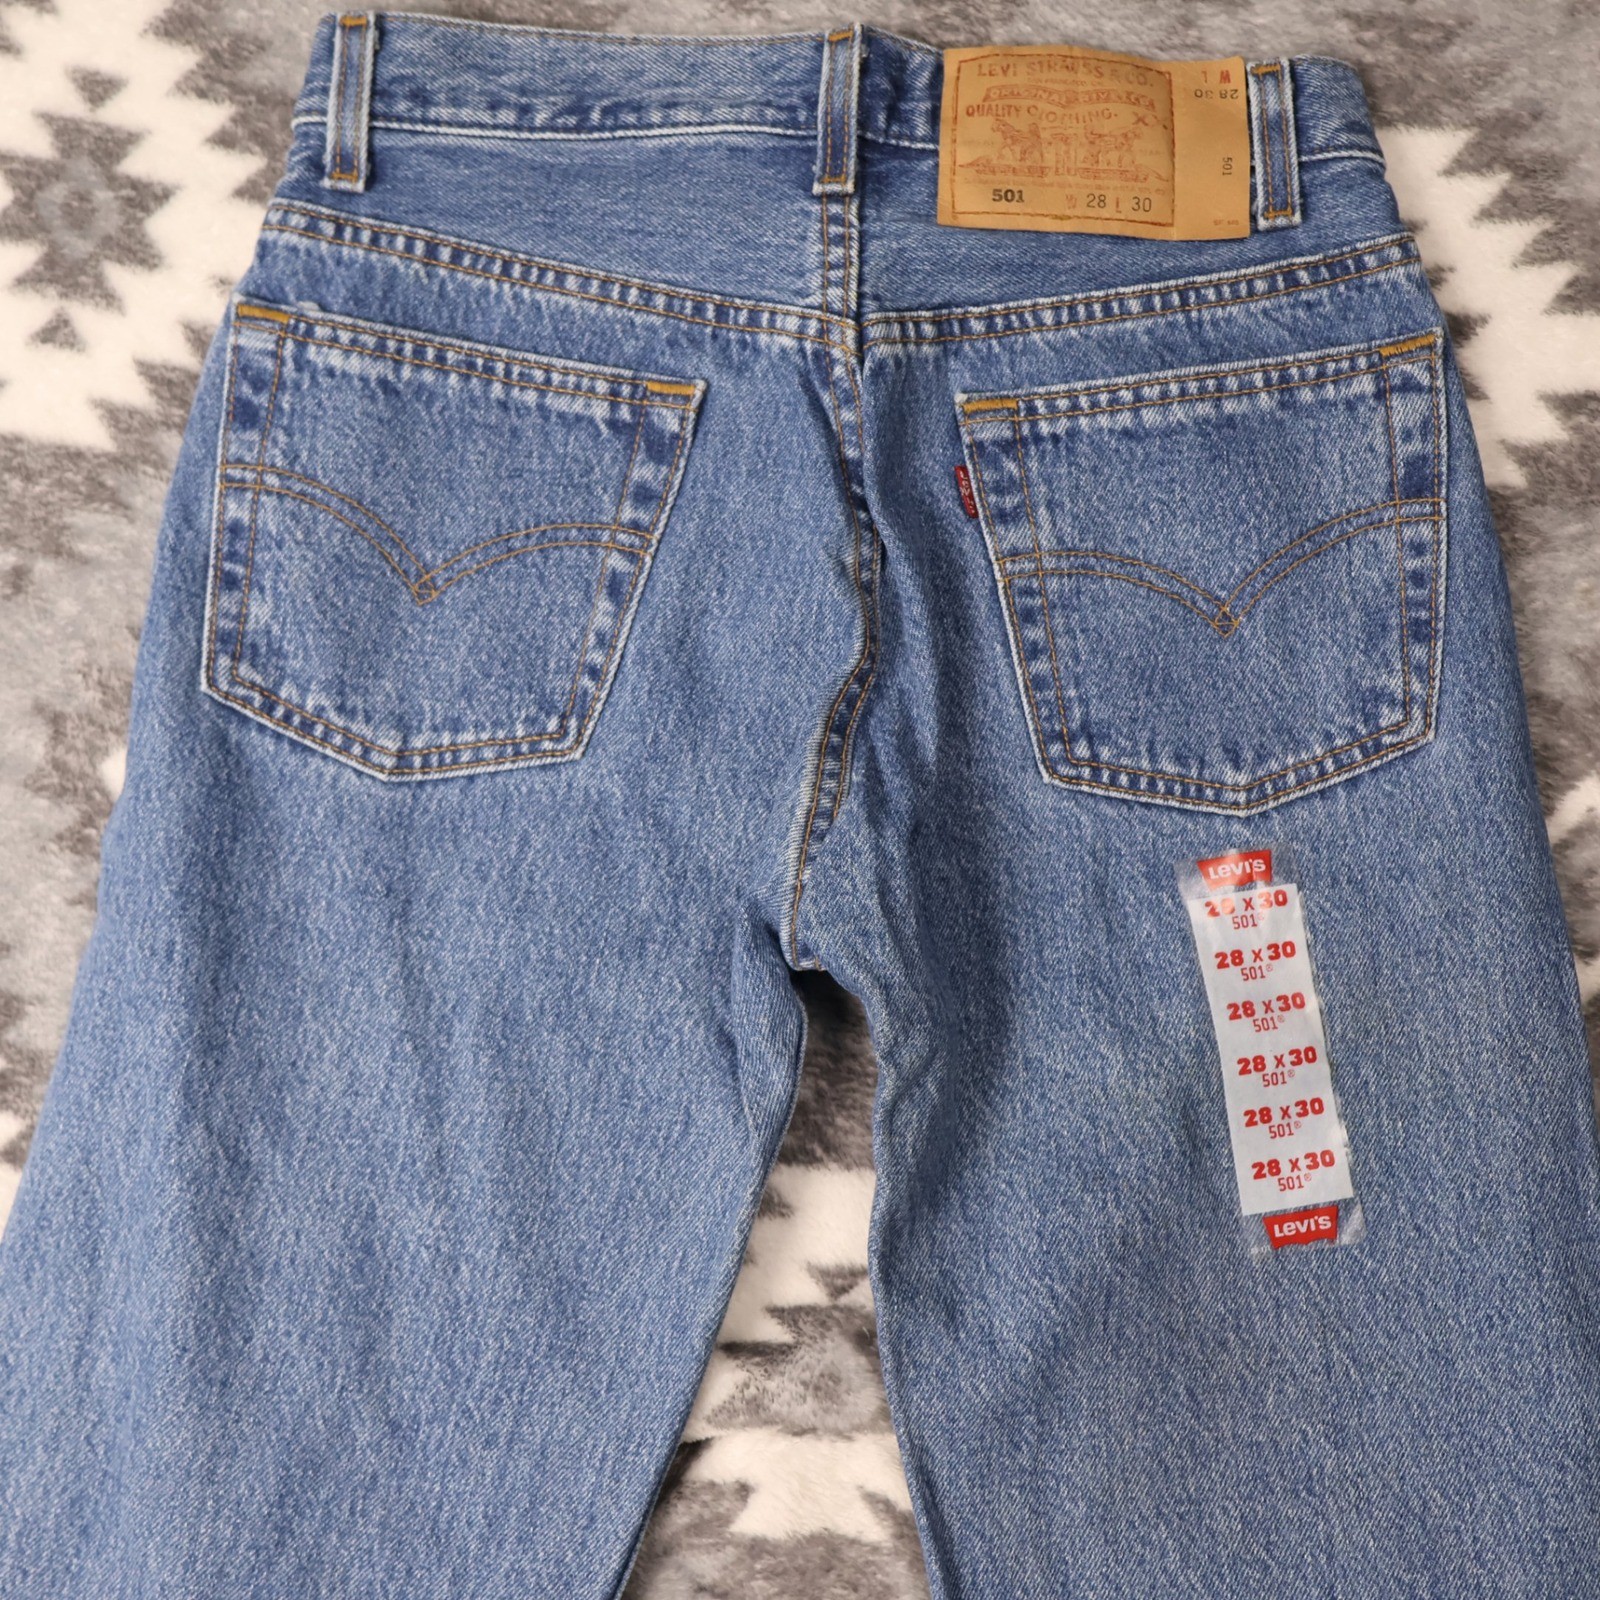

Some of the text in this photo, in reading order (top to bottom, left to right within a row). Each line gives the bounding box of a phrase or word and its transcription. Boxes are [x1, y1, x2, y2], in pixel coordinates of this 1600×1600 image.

[977, 62, 1018, 77] LEVI
[1026, 58, 1105, 79] STRAUSS
[1219, 88, 1239, 100] 28
[965, 103, 1022, 118] QUALITY
[1222, 156, 1234, 177] 501
[992, 188, 1025, 203] 501
[1086, 193, 1107, 209] 28
[1131, 196, 1152, 213] 30
[1204, 897, 1236, 918] 28
[1257, 889, 1289, 909] 30
[1214, 949, 1244, 970] 28
[1266, 941, 1297, 961] 30
[1226, 1000, 1256, 1021] 28
[1275, 992, 1306, 1012] 30
[1237, 1055, 1267, 1076] 28
[1288, 1046, 1317, 1067] 30
[1243, 1106, 1273, 1128] 28
[1294, 1097, 1325, 1118] 30
[1251, 1158, 1281, 1180] 28
[1304, 1149, 1335, 1171] 30
